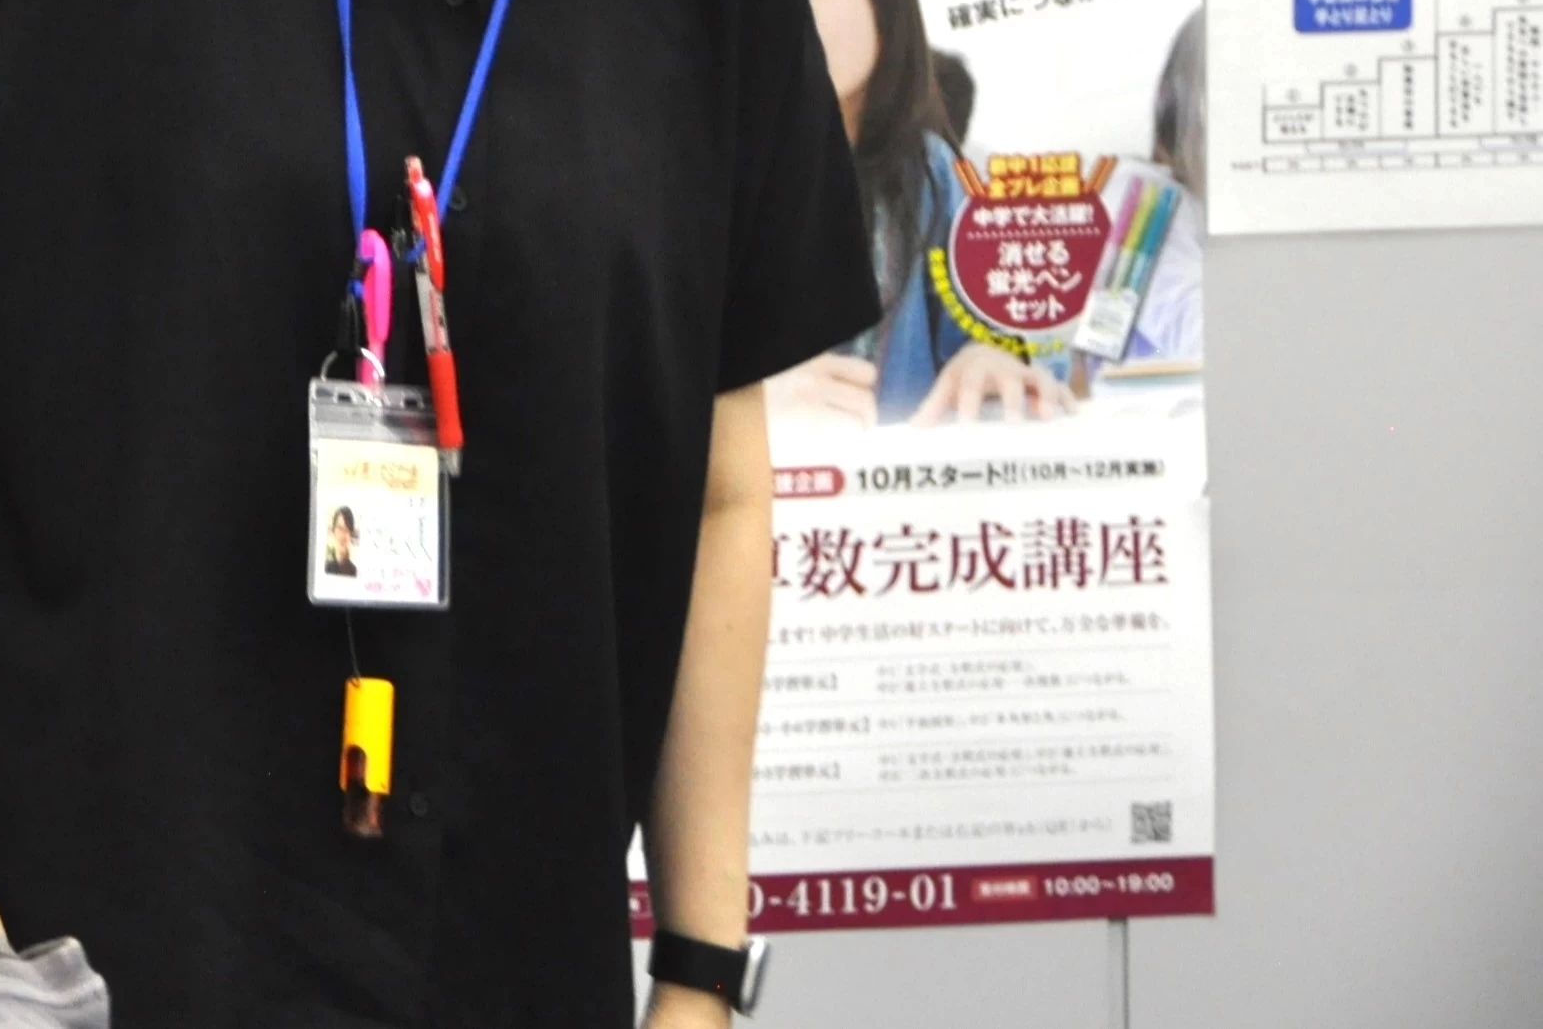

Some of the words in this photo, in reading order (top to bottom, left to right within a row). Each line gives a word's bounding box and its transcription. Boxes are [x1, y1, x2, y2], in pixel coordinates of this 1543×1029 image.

[997, 239, 1070, 267] 消せる
[1004, 293, 1066, 322] セット
